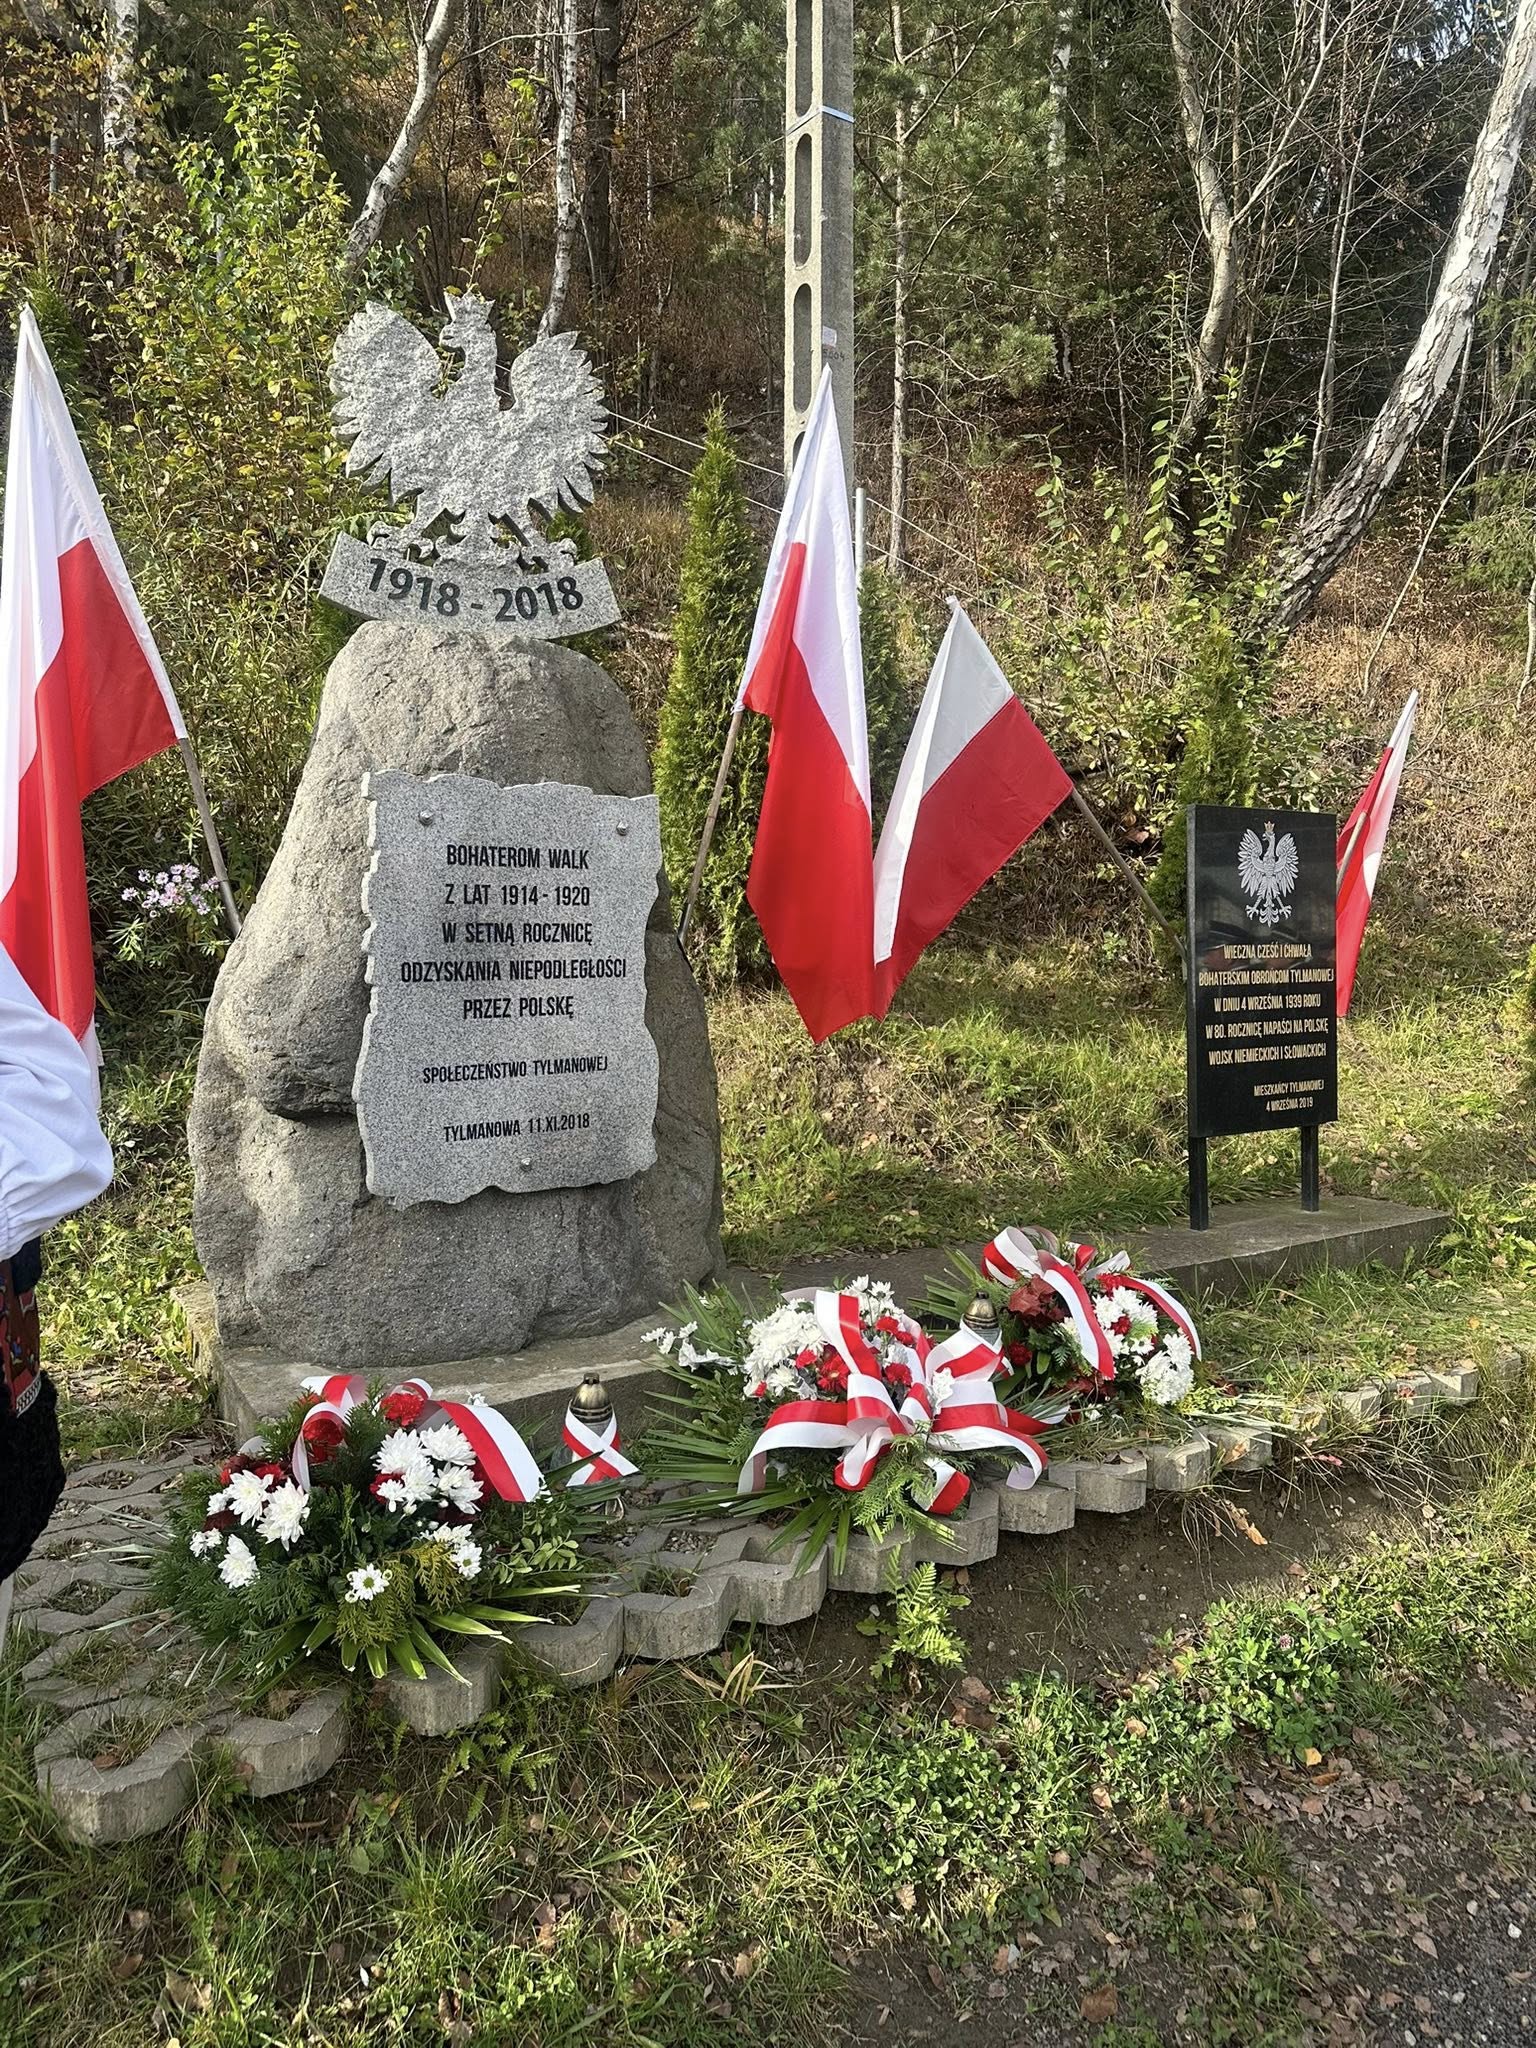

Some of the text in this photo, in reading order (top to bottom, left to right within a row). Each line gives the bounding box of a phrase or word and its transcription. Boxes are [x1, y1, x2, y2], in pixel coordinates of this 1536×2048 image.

[368, 557, 461, 617] 1918
[492, 576, 583, 622] 2018
[446, 844, 589, 870] BOHATEROM WALK
[444, 883, 455, 905] Z
[463, 884, 491, 905] LAT
[442, 922, 592, 946] W SETNĄ ROCZNICĘ
[1224, 943, 1256, 959] WIECZNA
[1257, 942, 1279, 958] CZEŚĆ
[1284, 943, 1312, 958] CHWAŁA
[401, 956, 627, 982] ODZYSKANIA NIEPODLEGŁOŚCI
[1199, 968, 1334, 986] BOHATERSKIM OBROŃCOM TYLMANOWEJ
[463, 995, 574, 1019] PRZEZ POLSKĘ
[1214, 993, 1321, 1012] W DNIU 4 WRZEŚNIA 1939 ROKU
[1205, 1018, 1328, 1039] W 80. ROCZNICĘ NAPAŚCI NA POLSKĘ
[1208, 1050, 1233, 1066] WOJSK
[1234, 1046, 1279, 1063] NIEMIECKICH
[1284, 1043, 1327, 1059] SŁOWACKICH
[423, 1056, 608, 1084] SPOŁECZEŃSTWO TYLMANOWEJ
[1253, 1079, 1324, 1097] MIESZKAŃCY TYLMANOWEJ
[1265, 1097, 1313, 1112] 4 WRZEŚNIA 2019
[443, 1113, 590, 1142] TYLMANOWA 11.XI.2018
